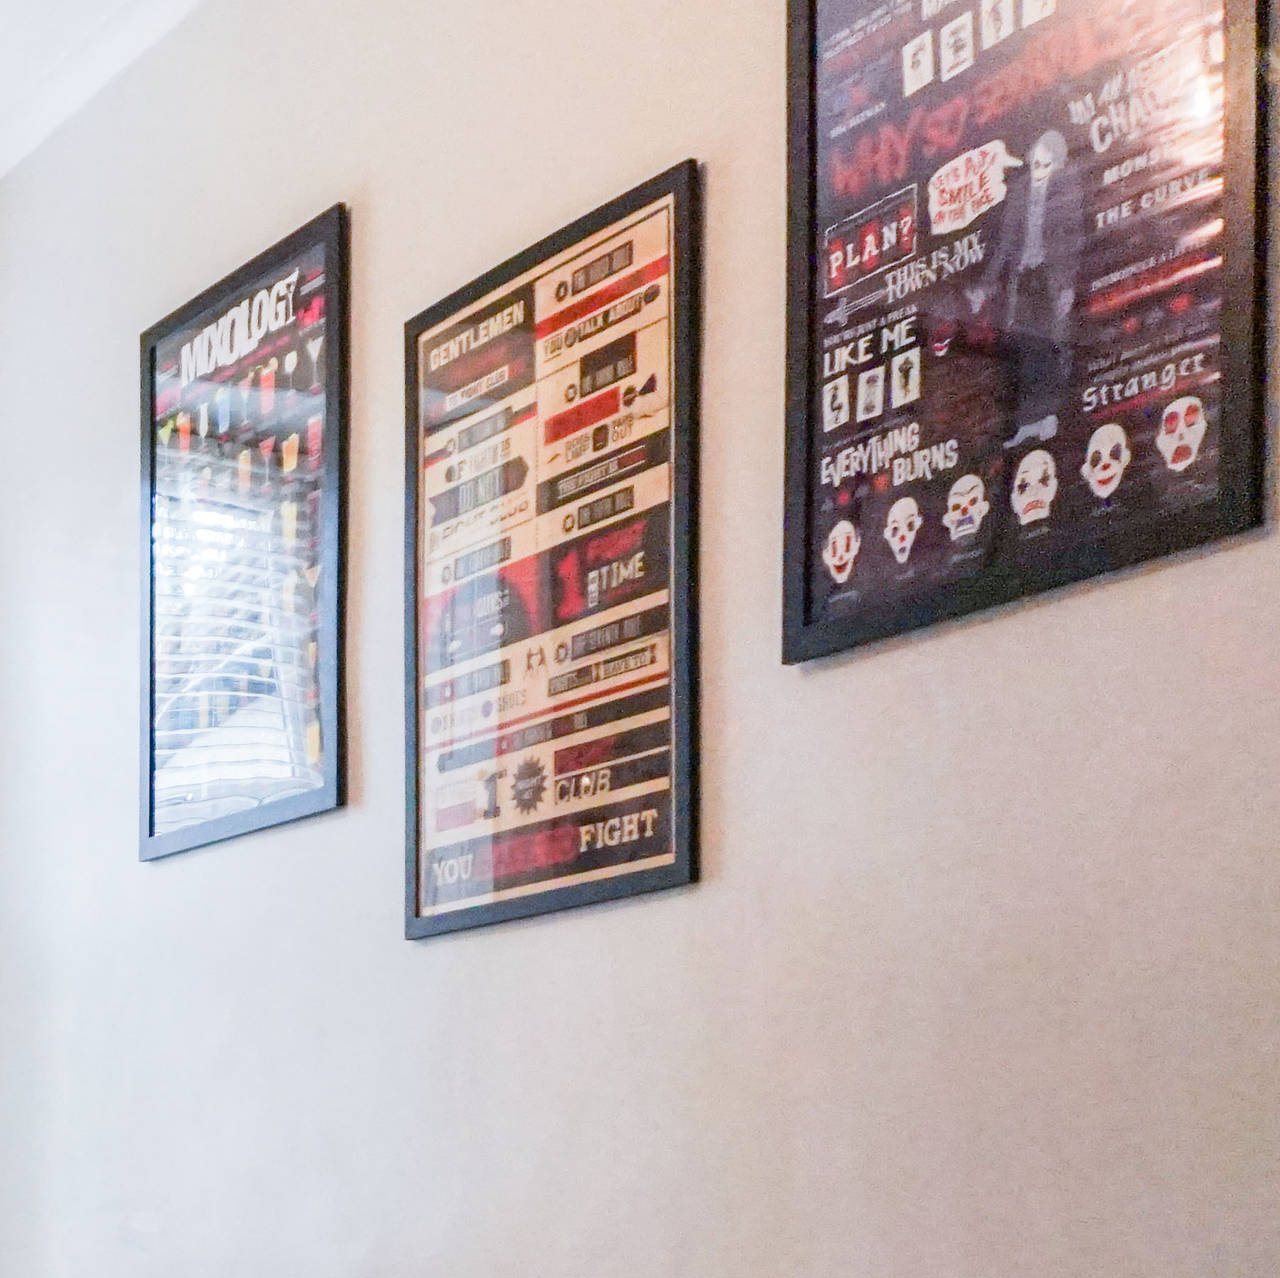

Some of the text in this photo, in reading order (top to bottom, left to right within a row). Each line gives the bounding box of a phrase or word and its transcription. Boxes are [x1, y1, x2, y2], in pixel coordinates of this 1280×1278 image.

[1095, 200, 1134, 229] THE
[829, 215, 913, 279] PLAN?
[179, 266, 300, 388] MIXOLOGY
[429, 299, 525, 373] GENTLEMEN
[823, 333, 875, 379] LIKE
[881, 316, 918, 355] ME
[1081, 352, 1205, 412] Stranger
[820, 421, 920, 488] EVERYTHING
[892, 438, 959, 487] BURNS
[600, 551, 646, 592] TIME
[431, 854, 476, 887] YOU
[579, 808, 659, 854] FIGHT
